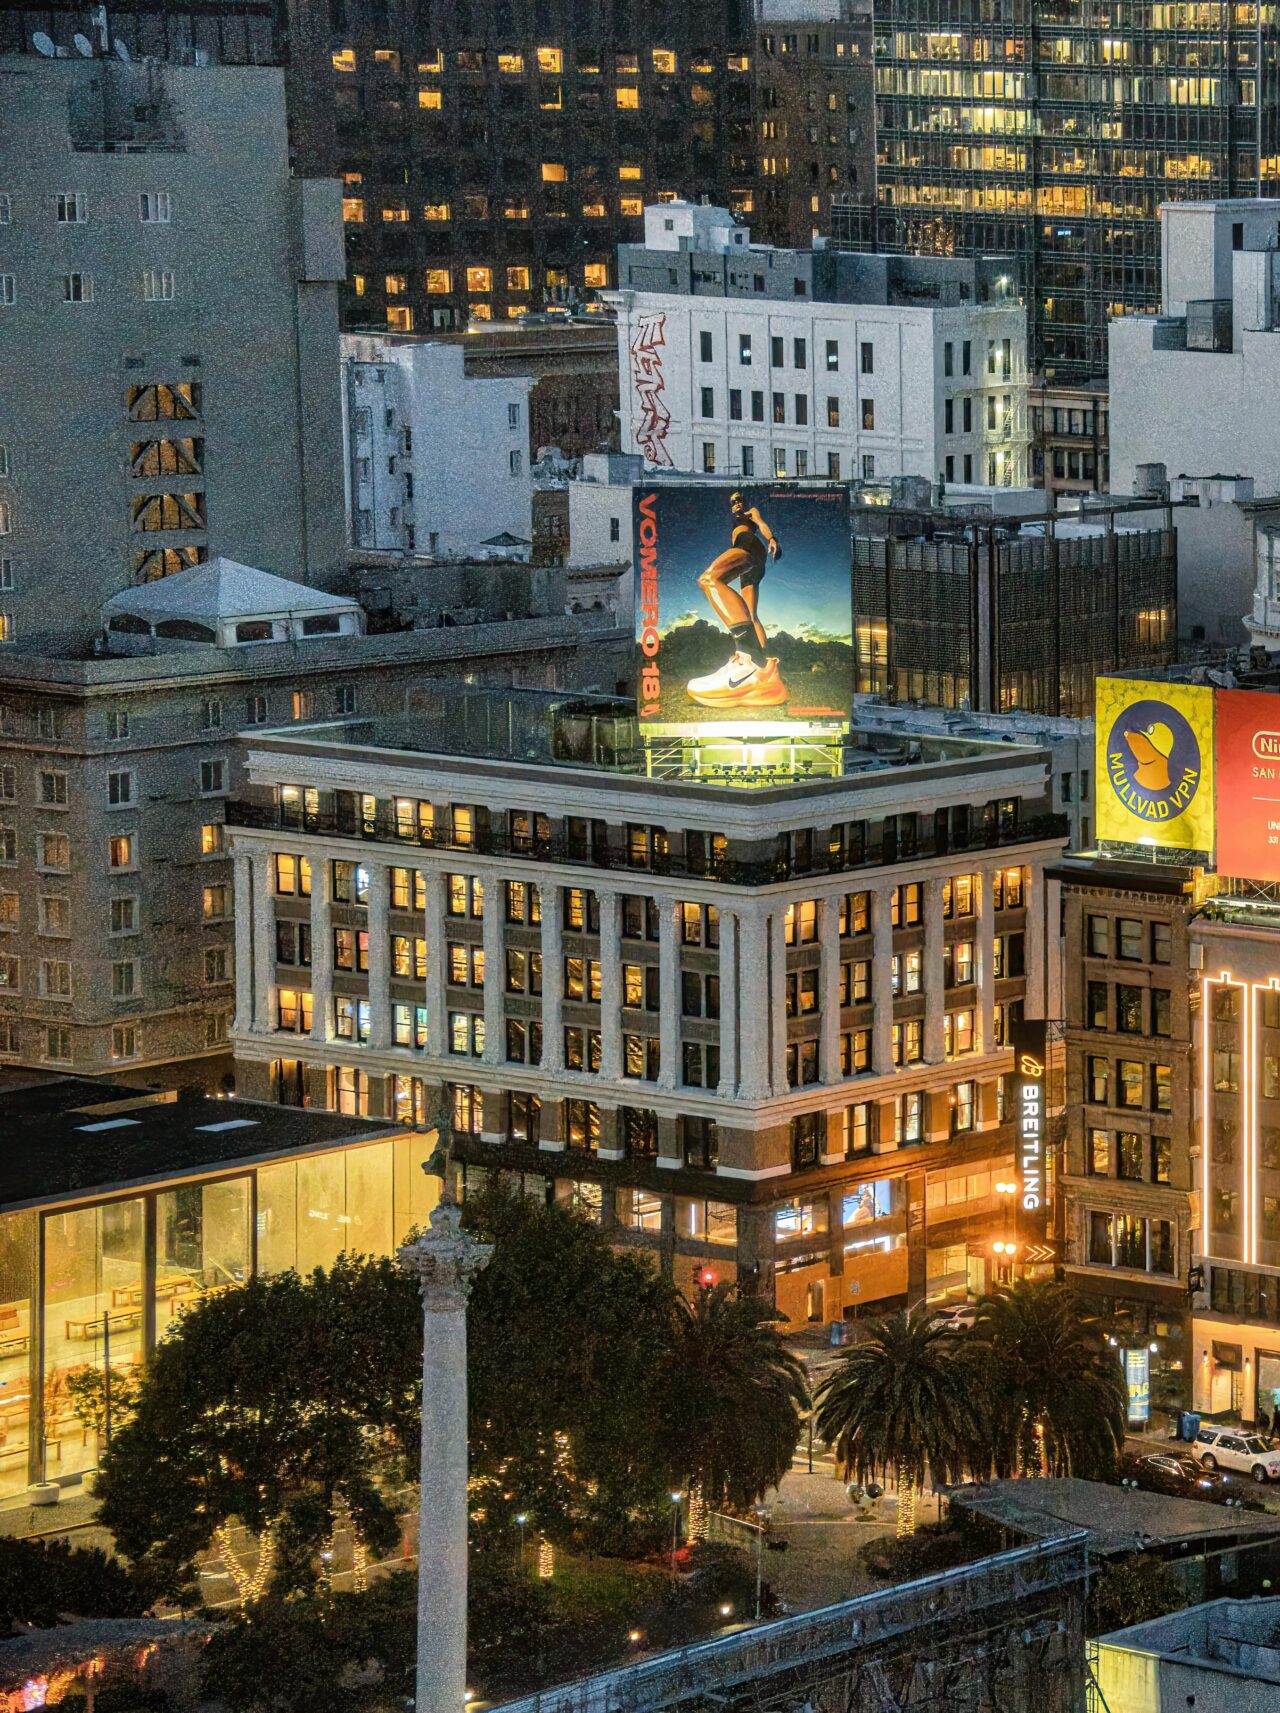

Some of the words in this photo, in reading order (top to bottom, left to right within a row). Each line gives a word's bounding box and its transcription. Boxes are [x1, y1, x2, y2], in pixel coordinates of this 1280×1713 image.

[638, 493, 660, 657] VOMERO
[640, 662, 660, 701] 18
[1109, 752, 1169, 819] MULLVAD
[1169, 767, 1198, 809] VPN
[1252, 767, 1275, 778] SAN
[1022, 1085, 1039, 1210] BREITLING
